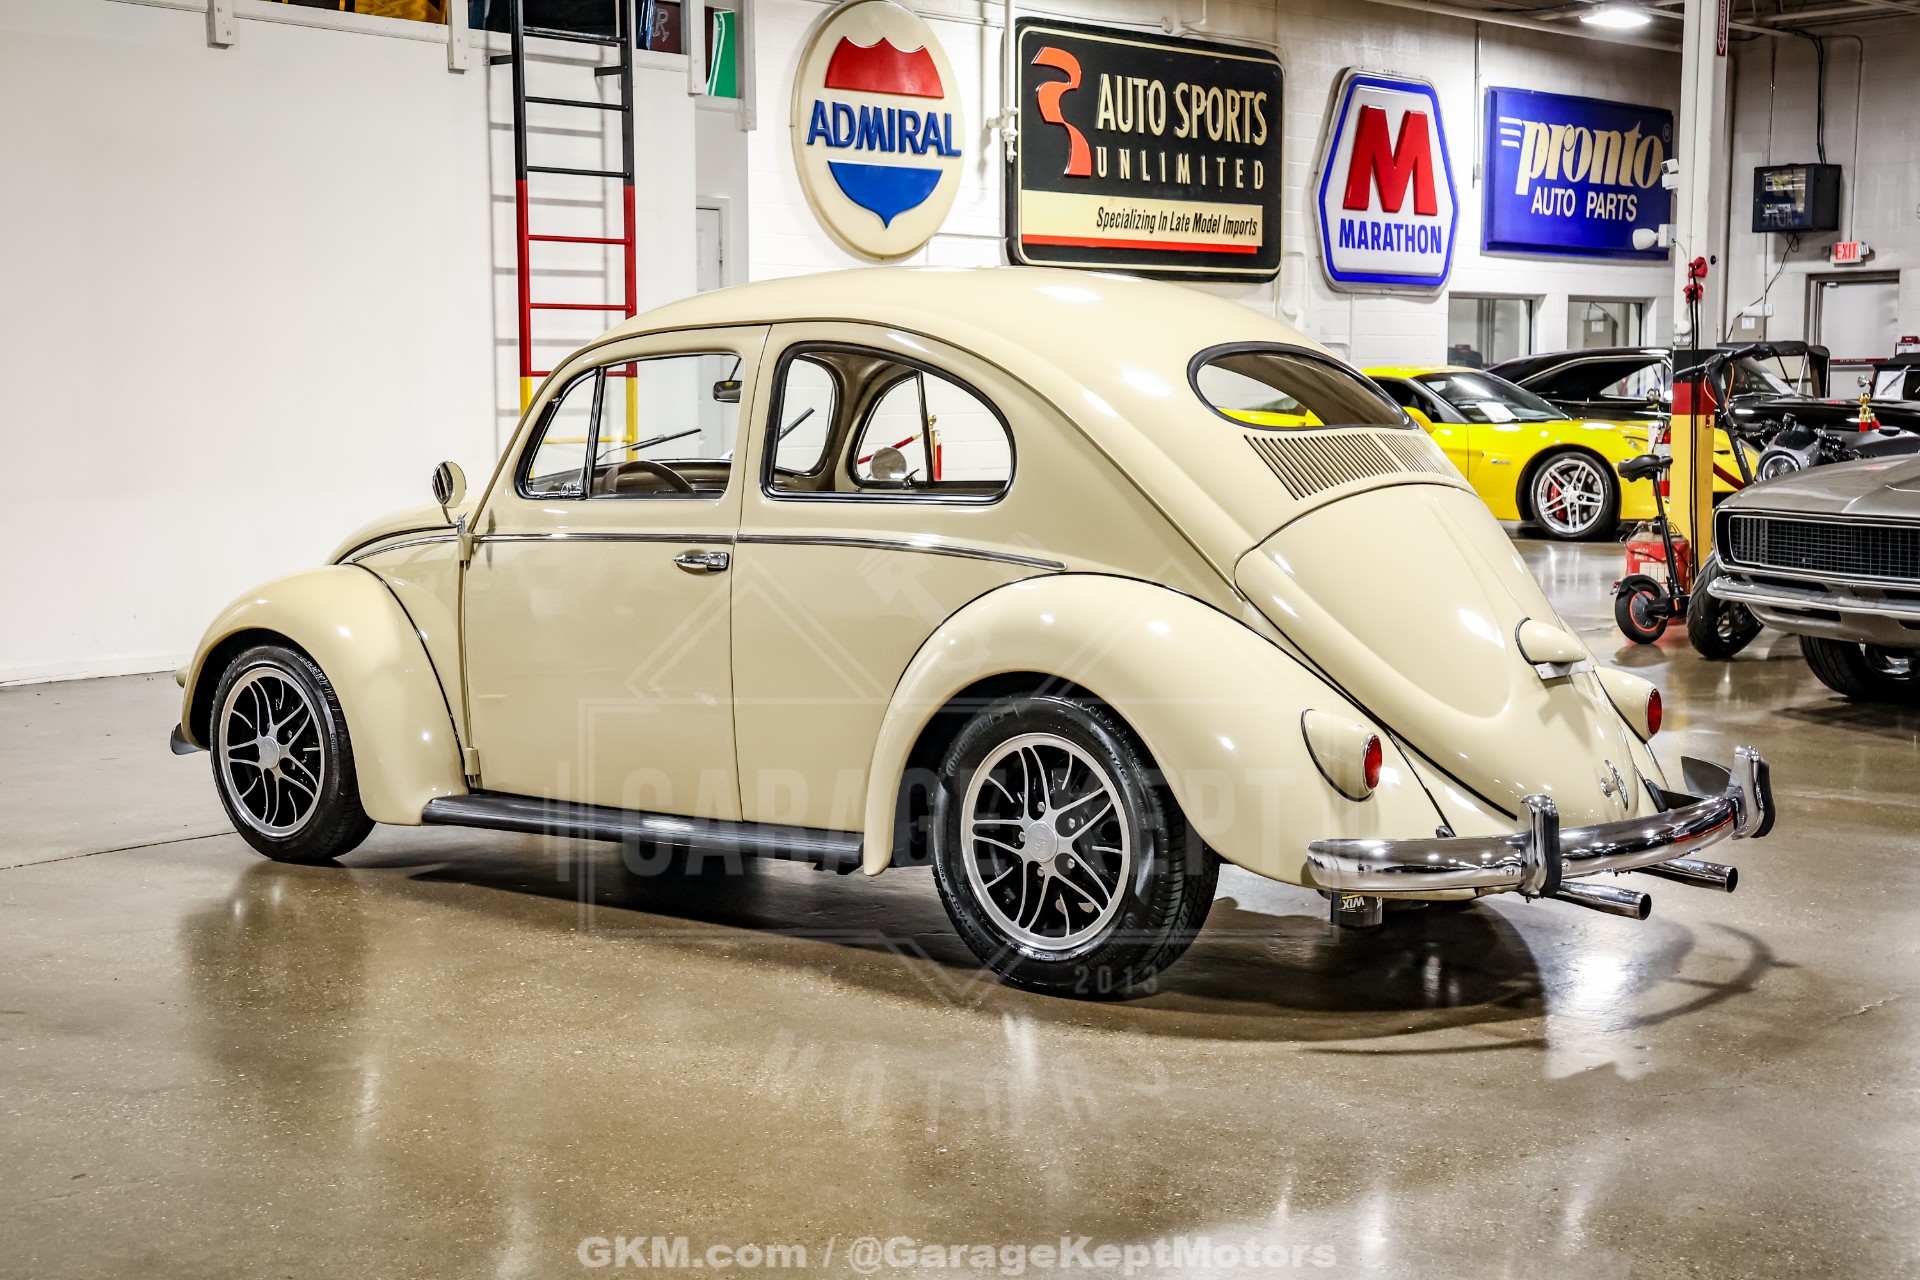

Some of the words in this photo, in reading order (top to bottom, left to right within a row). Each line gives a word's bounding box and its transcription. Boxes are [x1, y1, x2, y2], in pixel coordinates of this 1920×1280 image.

[806, 99, 962, 157] ADMIRAL
[1096, 73, 1166, 136] AUTO
[1173, 82, 1268, 146] SPORTS
[1096, 146, 1264, 190] UNLIMITED
[1342, 104, 1438, 216] M
[1515, 119, 1664, 196] pronto
[1096, 206, 1156, 235] Specializing
[1158, 213, 1168, 231] In
[1169, 214, 1190, 233] Late
[1191, 213, 1221, 235] Model
[1222, 218, 1258, 237] Imports
[1530, 186, 1576, 217] AUTO
[1585, 190, 1638, 222] PARTS
[1339, 218, 1442, 254] MARATHON
[1835, 242, 1858, 260] EXIT
[1341, 896, 1365, 910] WIX
